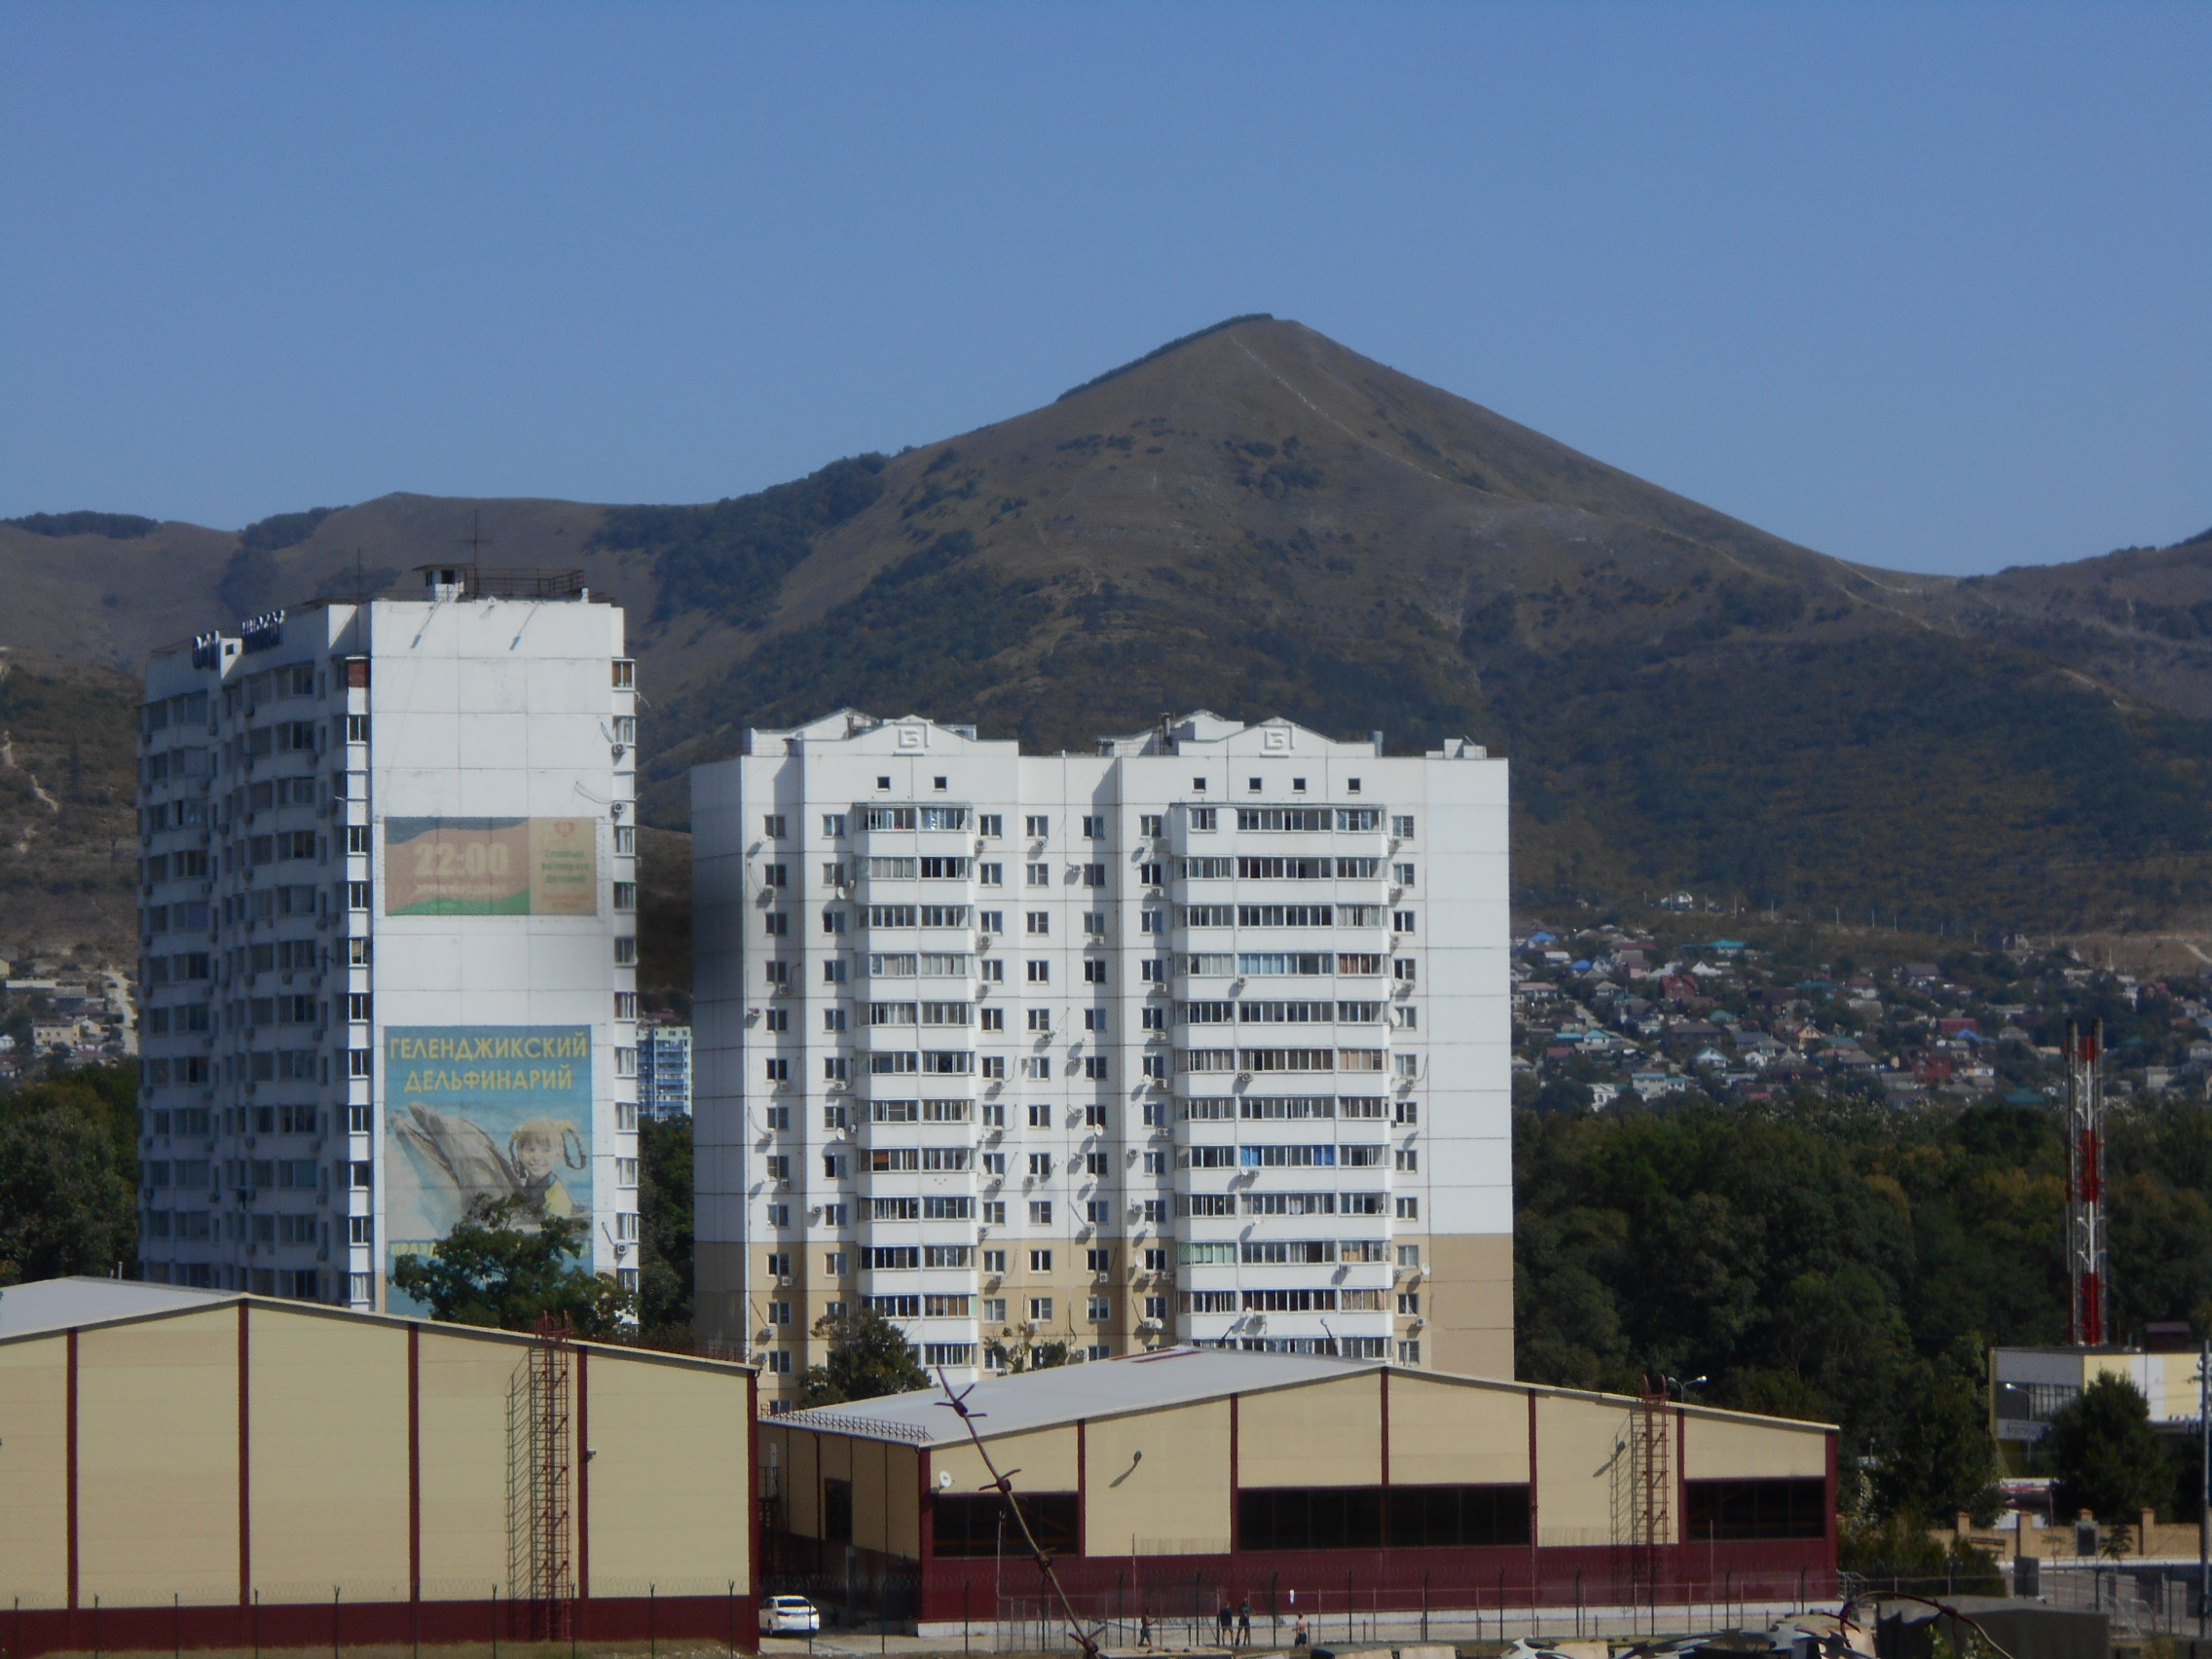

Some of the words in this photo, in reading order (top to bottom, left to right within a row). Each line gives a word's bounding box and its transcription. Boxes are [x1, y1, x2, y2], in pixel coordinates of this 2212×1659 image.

[414, 842, 508, 876] 22:00
[389, 1031, 588, 1062] ГЕЛЕНДЖИКСКИЙ
[404, 1063, 572, 1093] ДЕЛЬФИНАРИЙ
